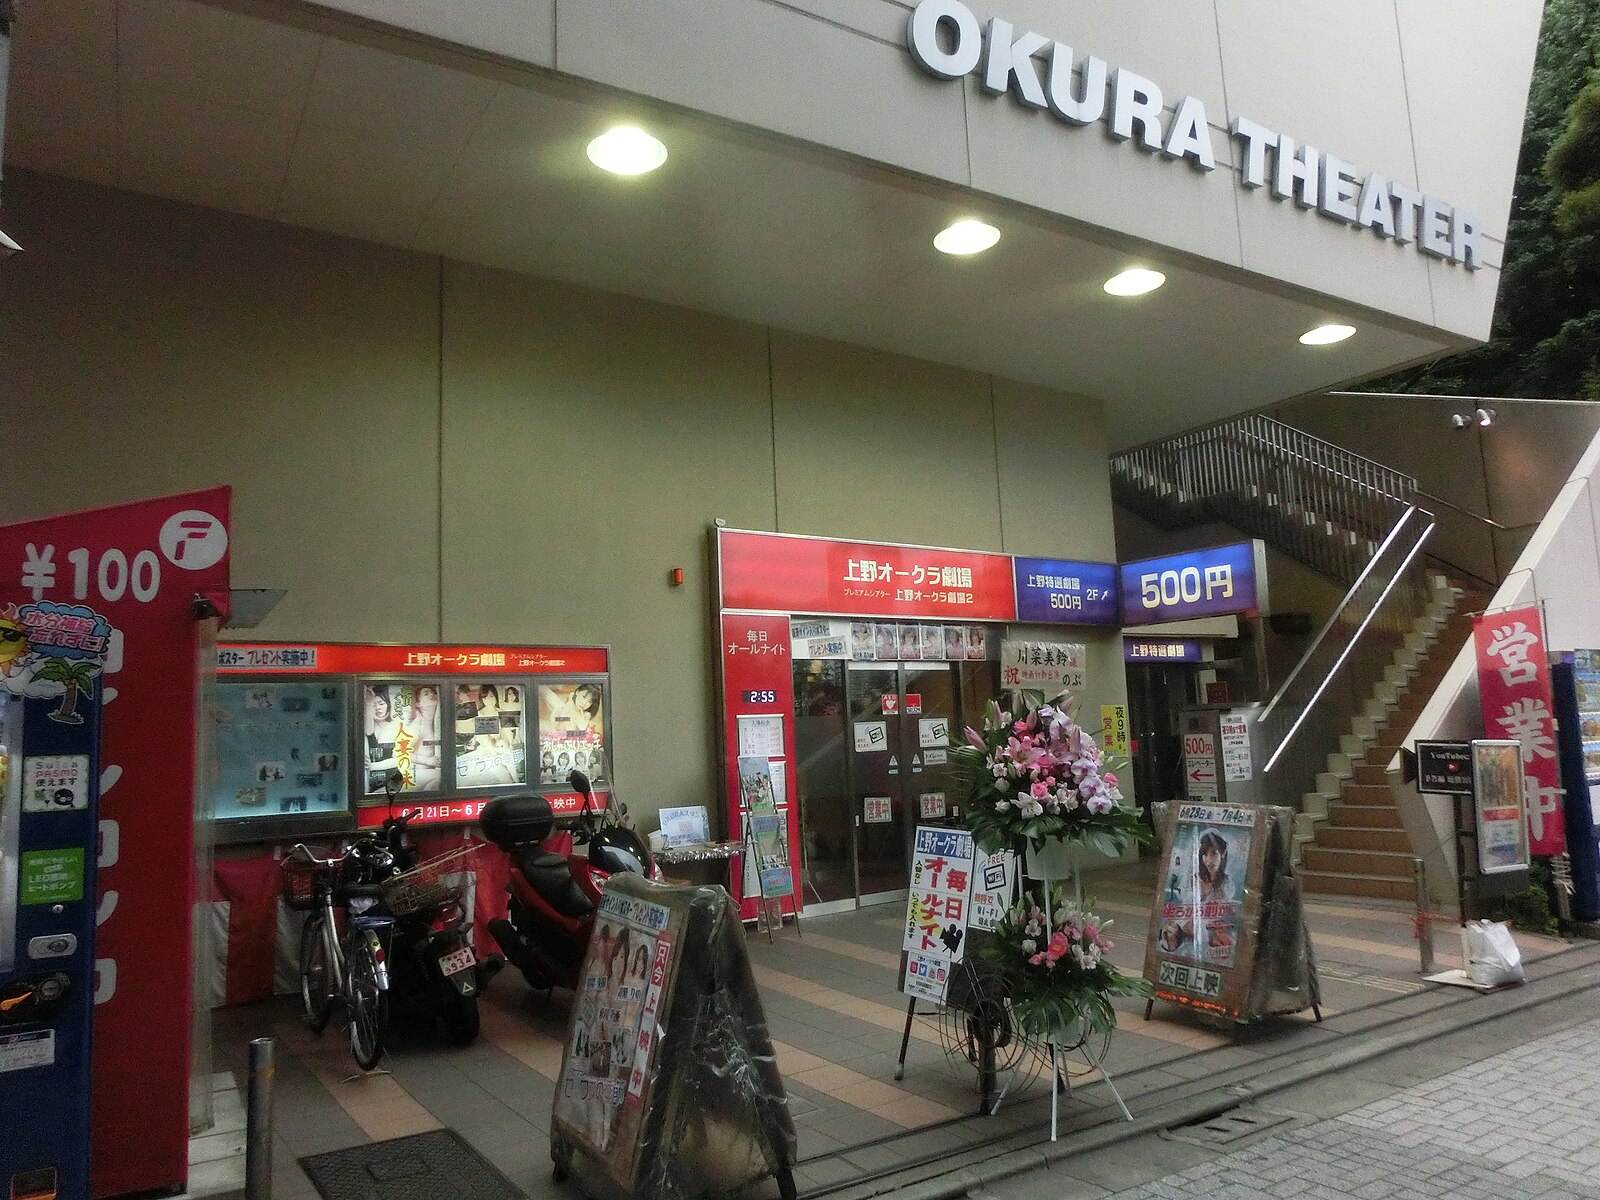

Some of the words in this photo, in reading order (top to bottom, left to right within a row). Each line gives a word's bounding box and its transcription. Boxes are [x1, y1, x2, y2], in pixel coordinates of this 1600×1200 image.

[907, 0, 1215, 172] OKURA
[1232, 117, 1484, 270] THEATER
[22, 542, 161, 603] ¥100
[843, 559, 973, 588] 上野オークラ劇場
[1027, 575, 1081, 590] 上野特選劇場
[1141, 564, 1233, 609] 500円
[894, 588, 973, 604] 上野オークラ劇場2
[1050, 593, 1082, 610] 500円
[1086, 588, 1099, 600] 2F
[746, 630, 768, 642] 毎日
[728, 643, 786, 656] オールナイト
[1131, 645, 1185, 657] 上野特選劇場
[403, 653, 505, 666] 上野オークラ劇場
[1004, 665, 1020, 685] 祝
[1062, 674, 1082, 686] のぶ
[750, 691, 775, 702] 2:55
[1486, 621, 1556, 841] 営業中
[1185, 737, 1213, 754] 500円
[1187, 760, 1214, 768] エレベーター
[36, 769, 78, 778] PASMO
[36, 778, 77, 787] 使えます
[918, 830, 972, 859] 上野オークラ劇場
[987, 854, 1005, 865] FREE
[945, 868, 968, 921] 毎日
[919, 857, 948, 950] オールナイト
[1159, 963, 1219, 994] 次回上映
